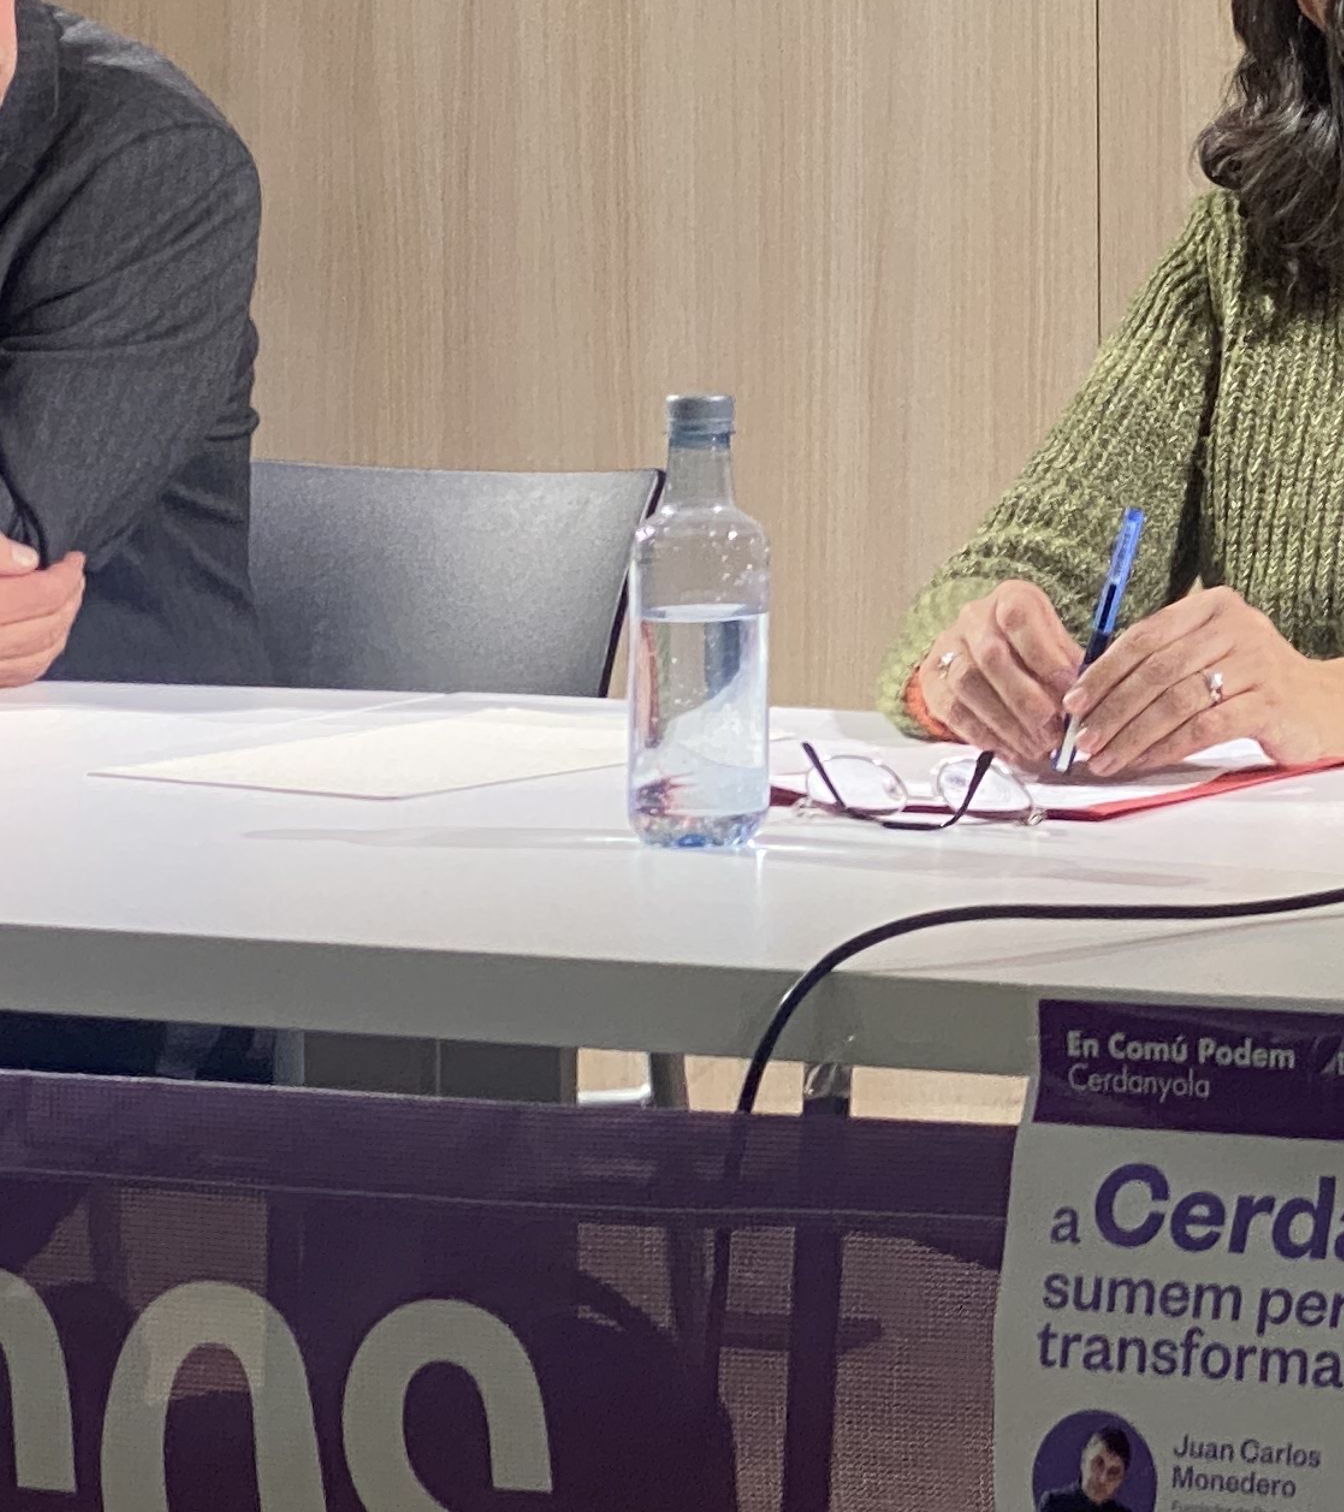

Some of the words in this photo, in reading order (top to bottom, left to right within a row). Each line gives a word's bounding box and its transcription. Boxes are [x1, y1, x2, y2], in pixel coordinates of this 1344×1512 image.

[1065, 1028, 1099, 1059] En
[1107, 1031, 1188, 1064] Comú
[1198, 1036, 1296, 1071] Podem
[1067, 1061, 1211, 1104] Cerdanyola
[1050, 1205, 1081, 1246] a
[1042, 1272, 1243, 1320] sumem
[1173, 1434, 1234, 1463] Juan
[1240, 1439, 1322, 1469] Carlos
[1171, 1464, 1297, 1498] Monedero
